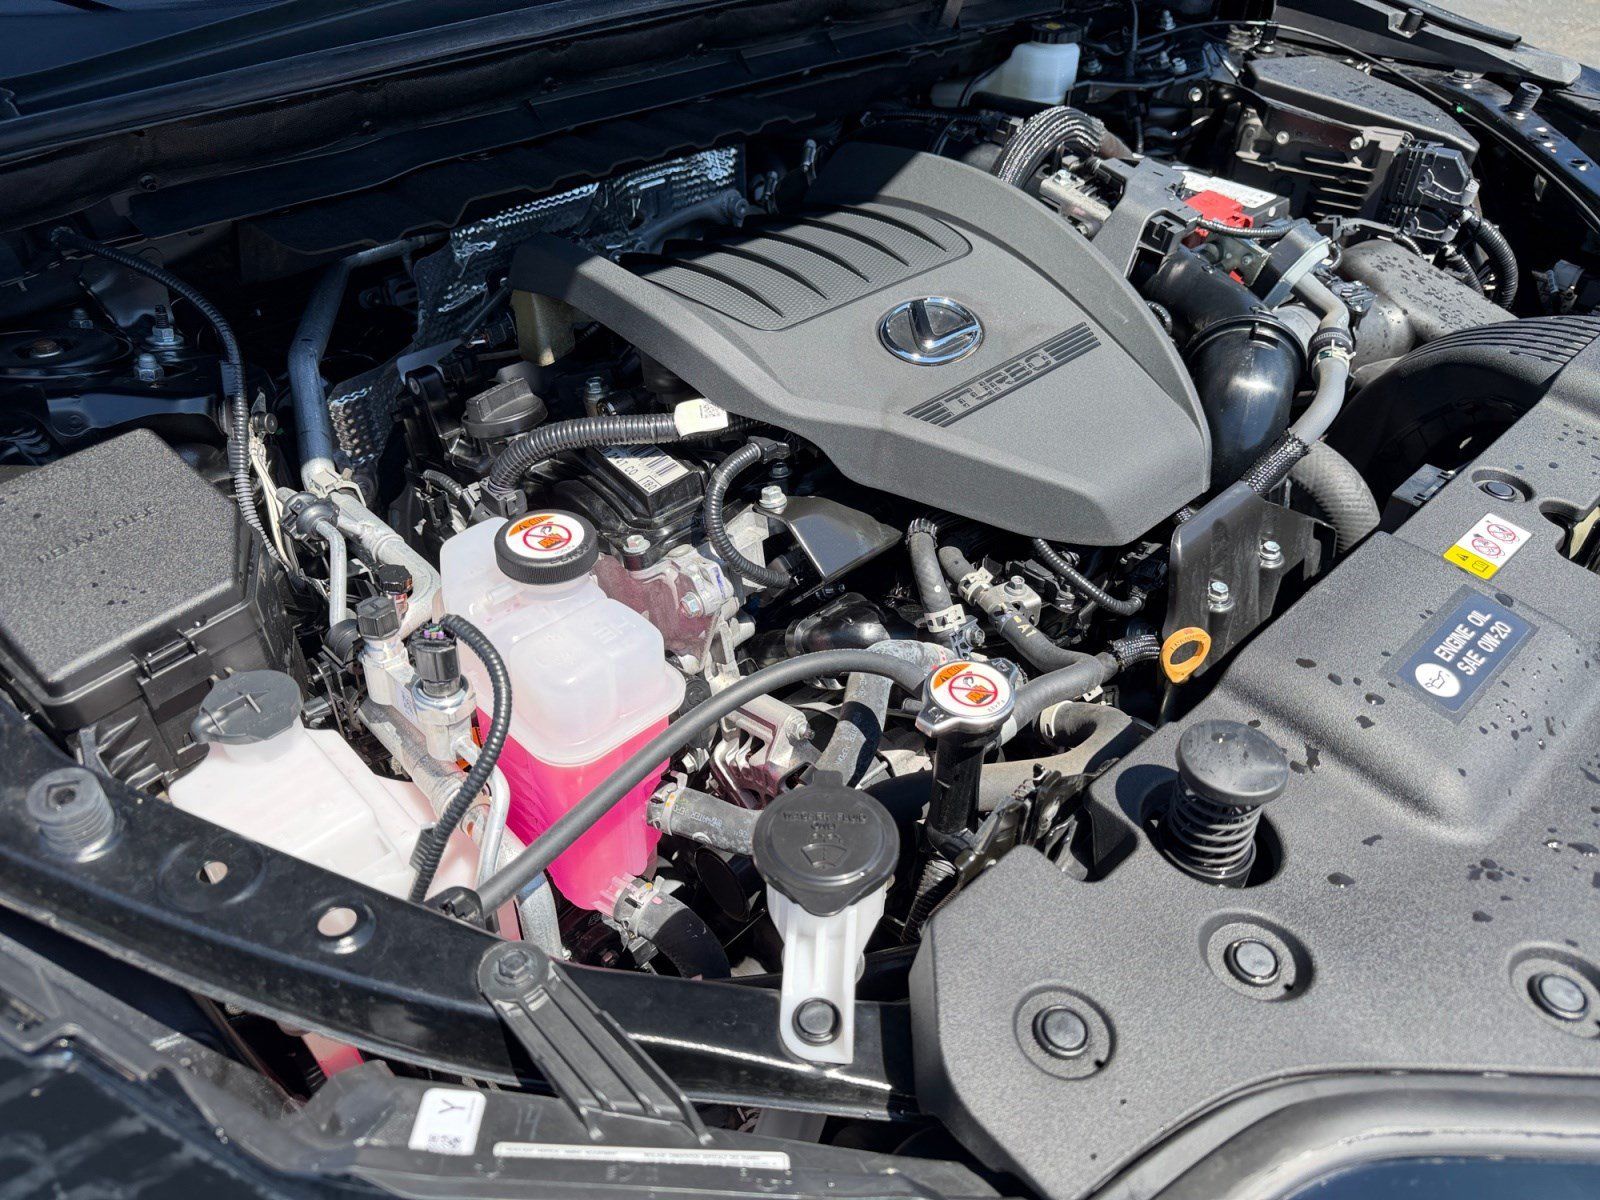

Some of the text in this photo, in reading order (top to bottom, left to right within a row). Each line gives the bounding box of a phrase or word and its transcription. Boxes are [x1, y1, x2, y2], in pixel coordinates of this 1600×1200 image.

[943, 352, 1052, 408] TURBO
[1433, 609, 1492, 663] ENGINE OIL
[1456, 620, 1512, 677] SAE 0W-20
